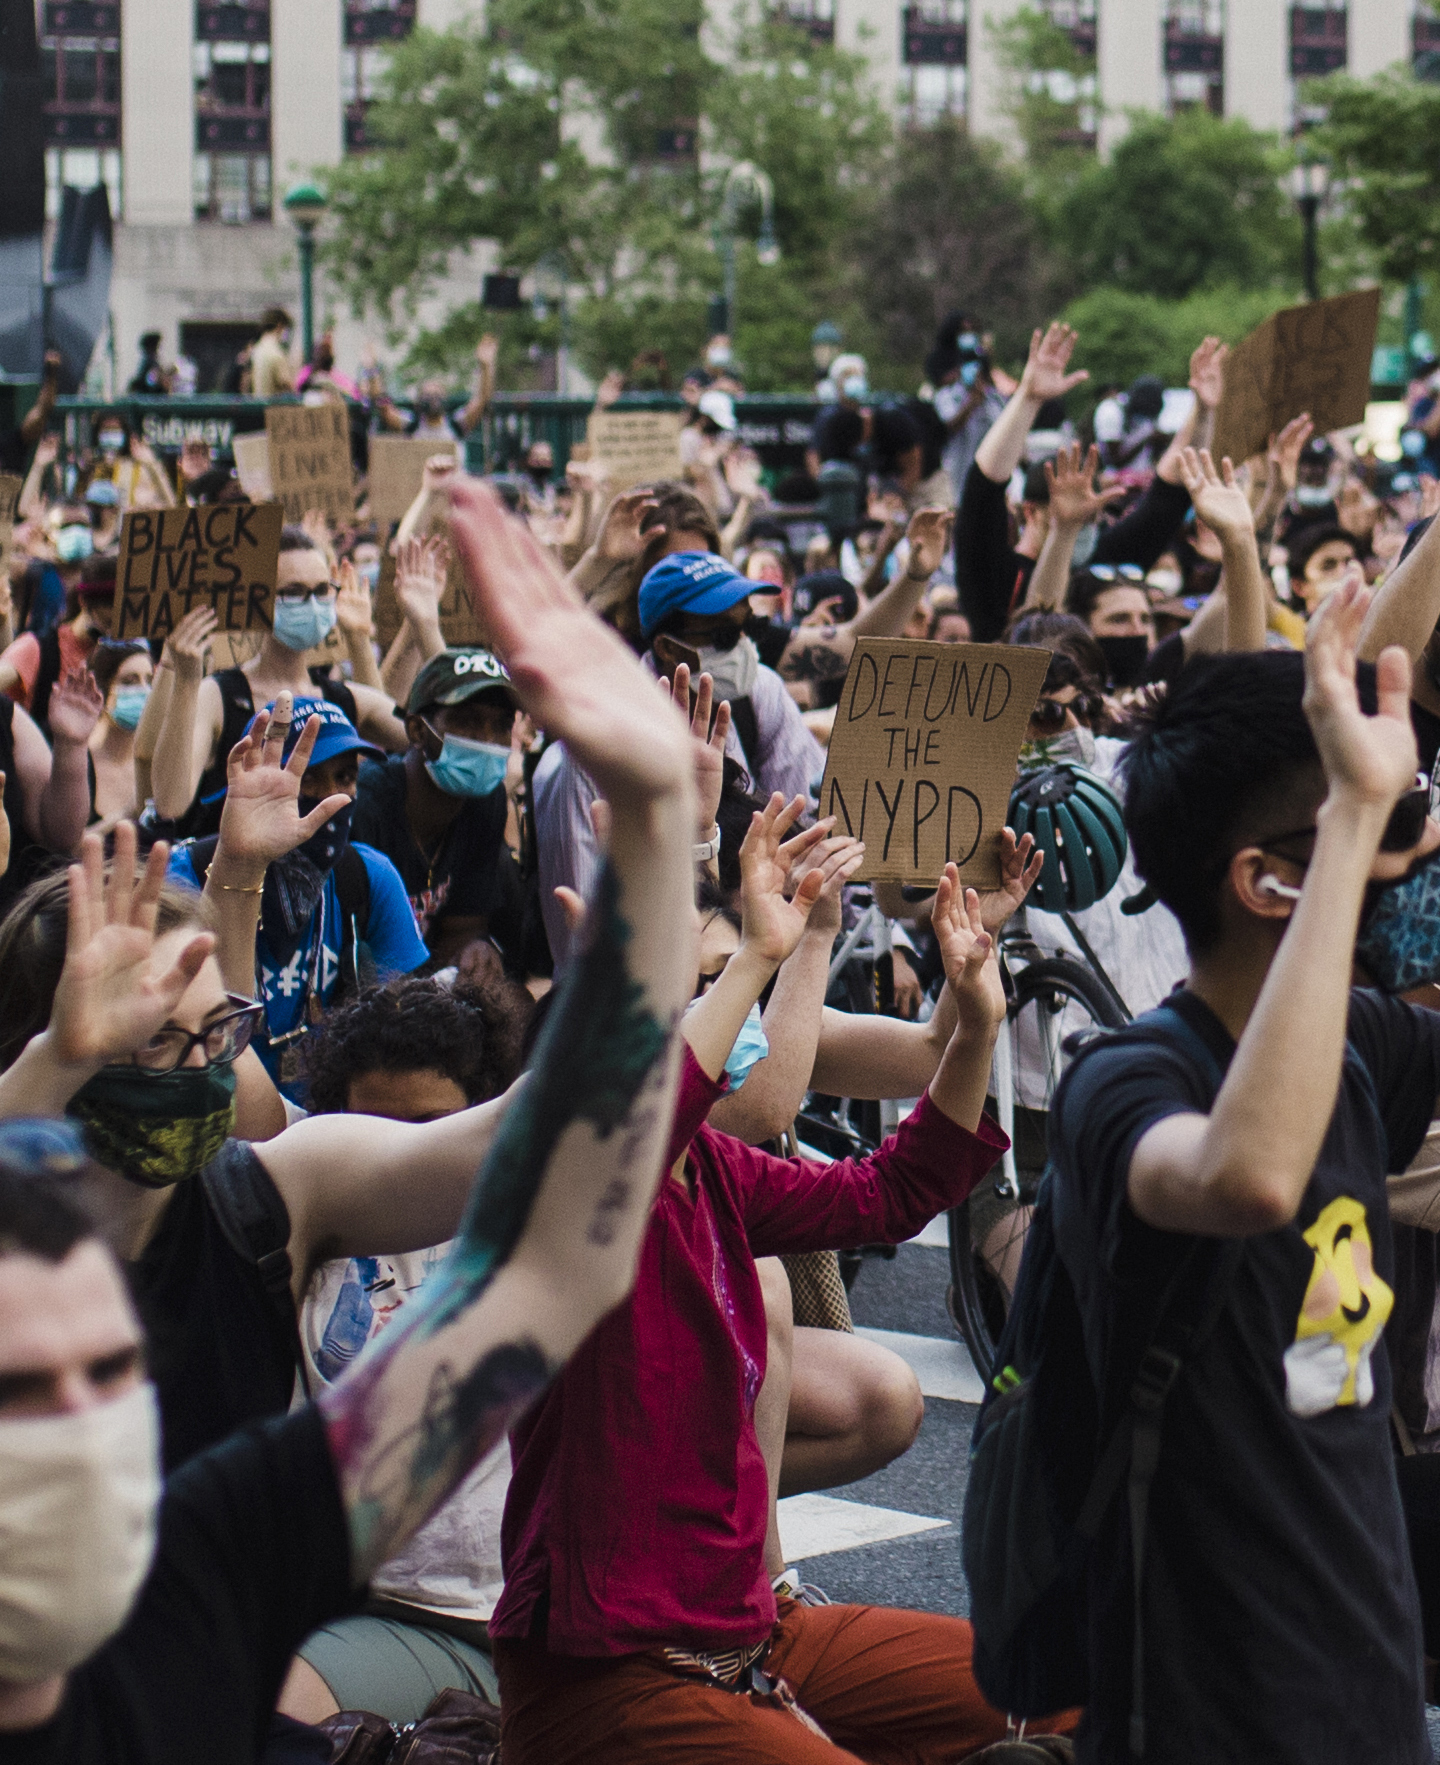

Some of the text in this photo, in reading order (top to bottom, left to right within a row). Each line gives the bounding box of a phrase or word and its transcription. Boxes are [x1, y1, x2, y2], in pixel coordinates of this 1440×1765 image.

[142, 414, 231, 447] Subway
[127, 507, 259, 556] BLACK
[123, 547, 243, 594] LIVES
[117, 583, 274, 638] MATTER
[848, 652, 1012, 723] DEFUND
[883, 728, 941, 771] THE
[827, 776, 983, 869] NYPD
